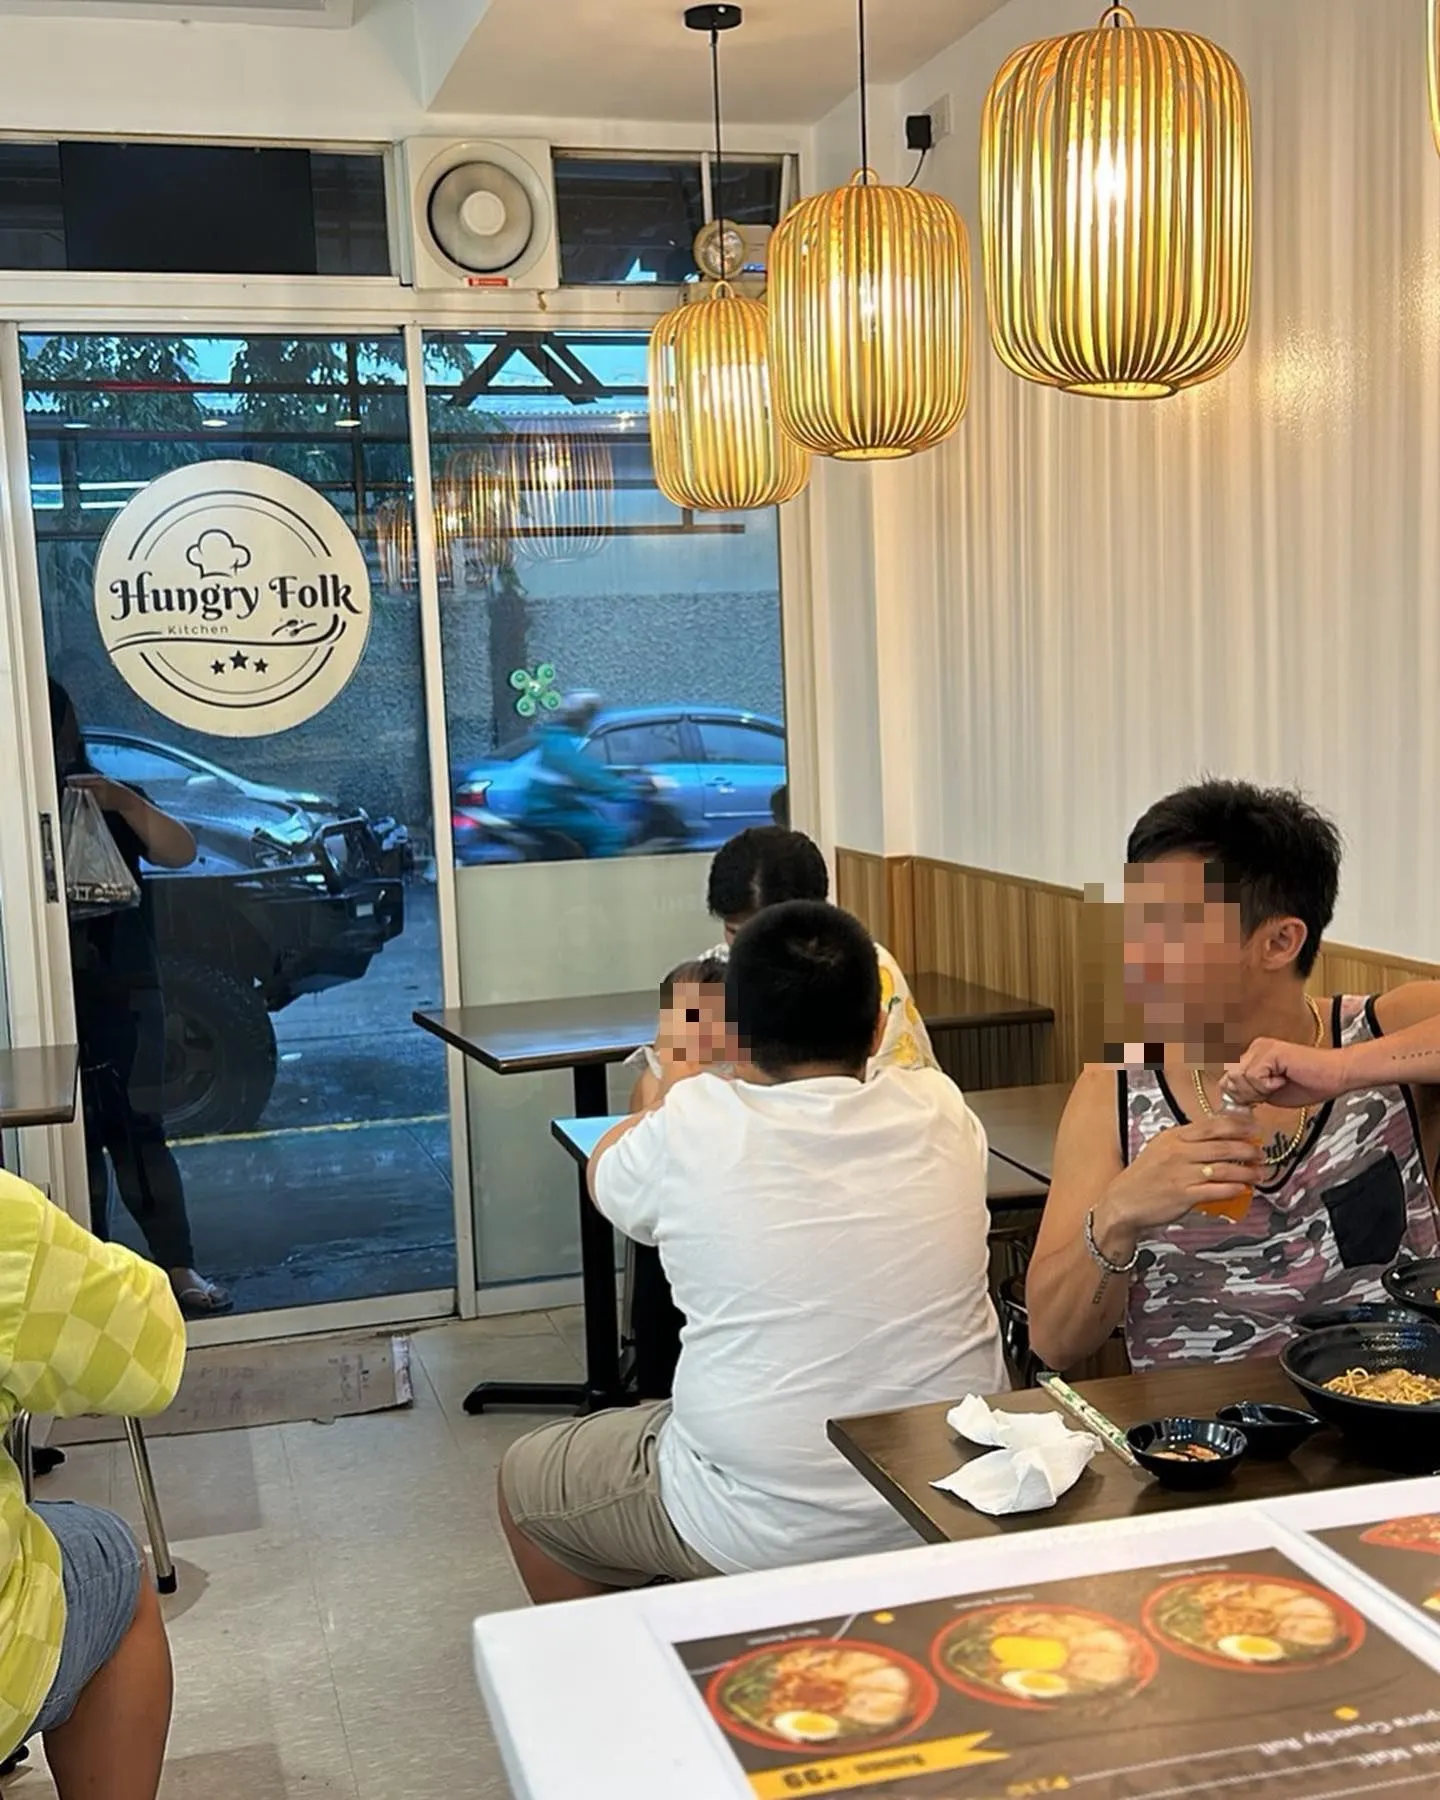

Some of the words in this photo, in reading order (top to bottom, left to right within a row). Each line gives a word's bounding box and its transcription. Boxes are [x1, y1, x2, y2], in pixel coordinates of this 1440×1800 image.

[109, 571, 260, 621] Hungry
[268, 574, 363, 614] Folk
[167, 624, 229, 636] Kitchen
